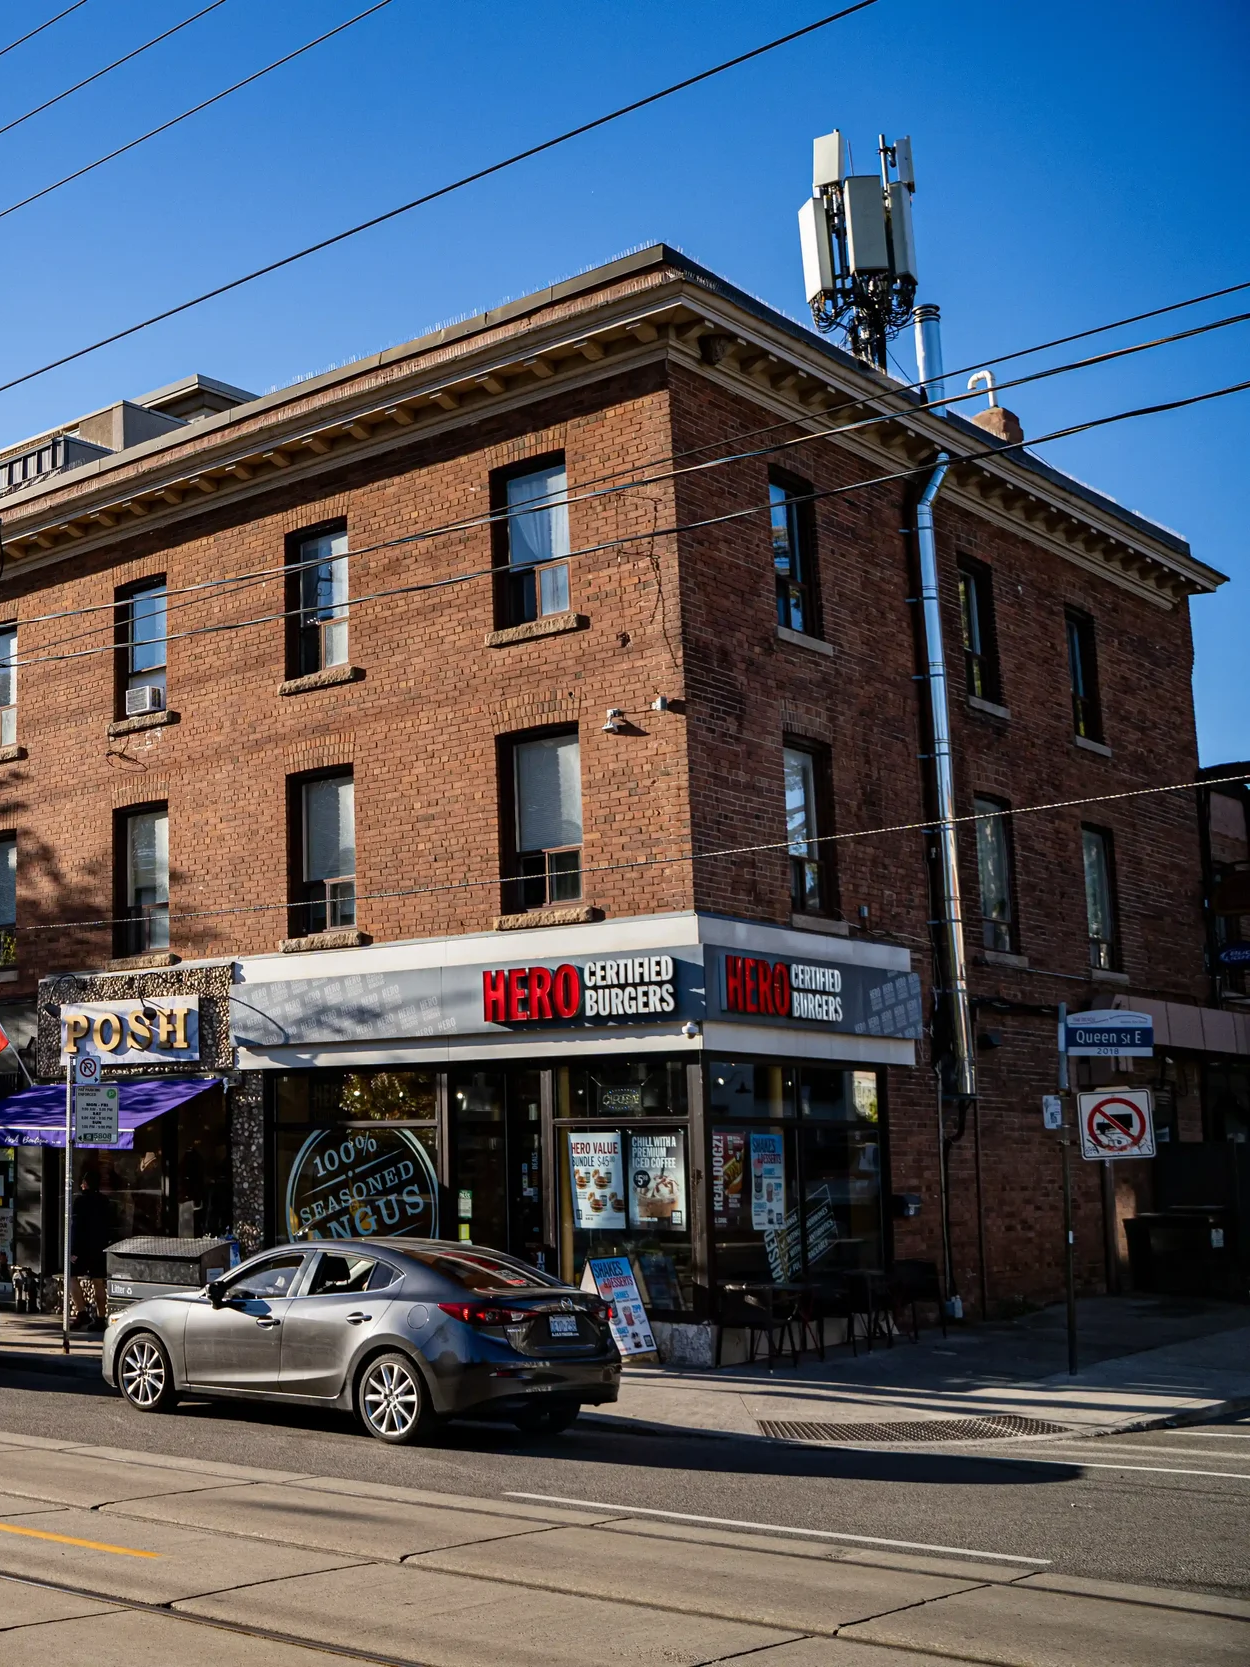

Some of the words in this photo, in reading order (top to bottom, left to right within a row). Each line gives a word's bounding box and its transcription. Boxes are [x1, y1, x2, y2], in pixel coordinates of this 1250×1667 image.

[584, 955, 673, 986] CERTIFIED
[790, 964, 842, 993] CERTIFIED
[382, 984, 400, 998] HERO
[483, 964, 580, 1022] HERO
[726, 955, 790, 1016] HERO
[585, 984, 675, 1016] BURGERS
[793, 992, 843, 1022] BURGERS
[398, 1005, 416, 1019] HERO
[64, 1008, 188, 1053] POSH
[438, 1017, 456, 1031] HERO
[1076, 1030, 1116, 1044] Queen
[1122, 1034, 1130, 1044] St
[1135, 1031, 1142, 1044] E
[4, 1135, 20, 1144] Posh
[22, 1136, 49, 1146] Boutique
[571, 1142, 590, 1154] HERO
[592, 1142, 618, 1154] VALUE
[632, 1136, 653, 1147] CHILL
[653, 1136, 670, 1147] WITH
[672, 1136, 676, 1148] A
[313, 1131, 378, 1178] 100%
[572, 1156, 594, 1167] BUNDLE
[632, 1148, 666, 1158] PREMIUM
[712, 1135, 724, 1176] DOGZ!
[632, 1158, 650, 1168] ICED
[651, 1158, 676, 1168] COFFEE
[300, 1160, 414, 1226] SEASONED
[712, 1176, 724, 1212] REAL
[592, 1260, 624, 1278] SHAKES
[112, 1284, 125, 1294] Litter
